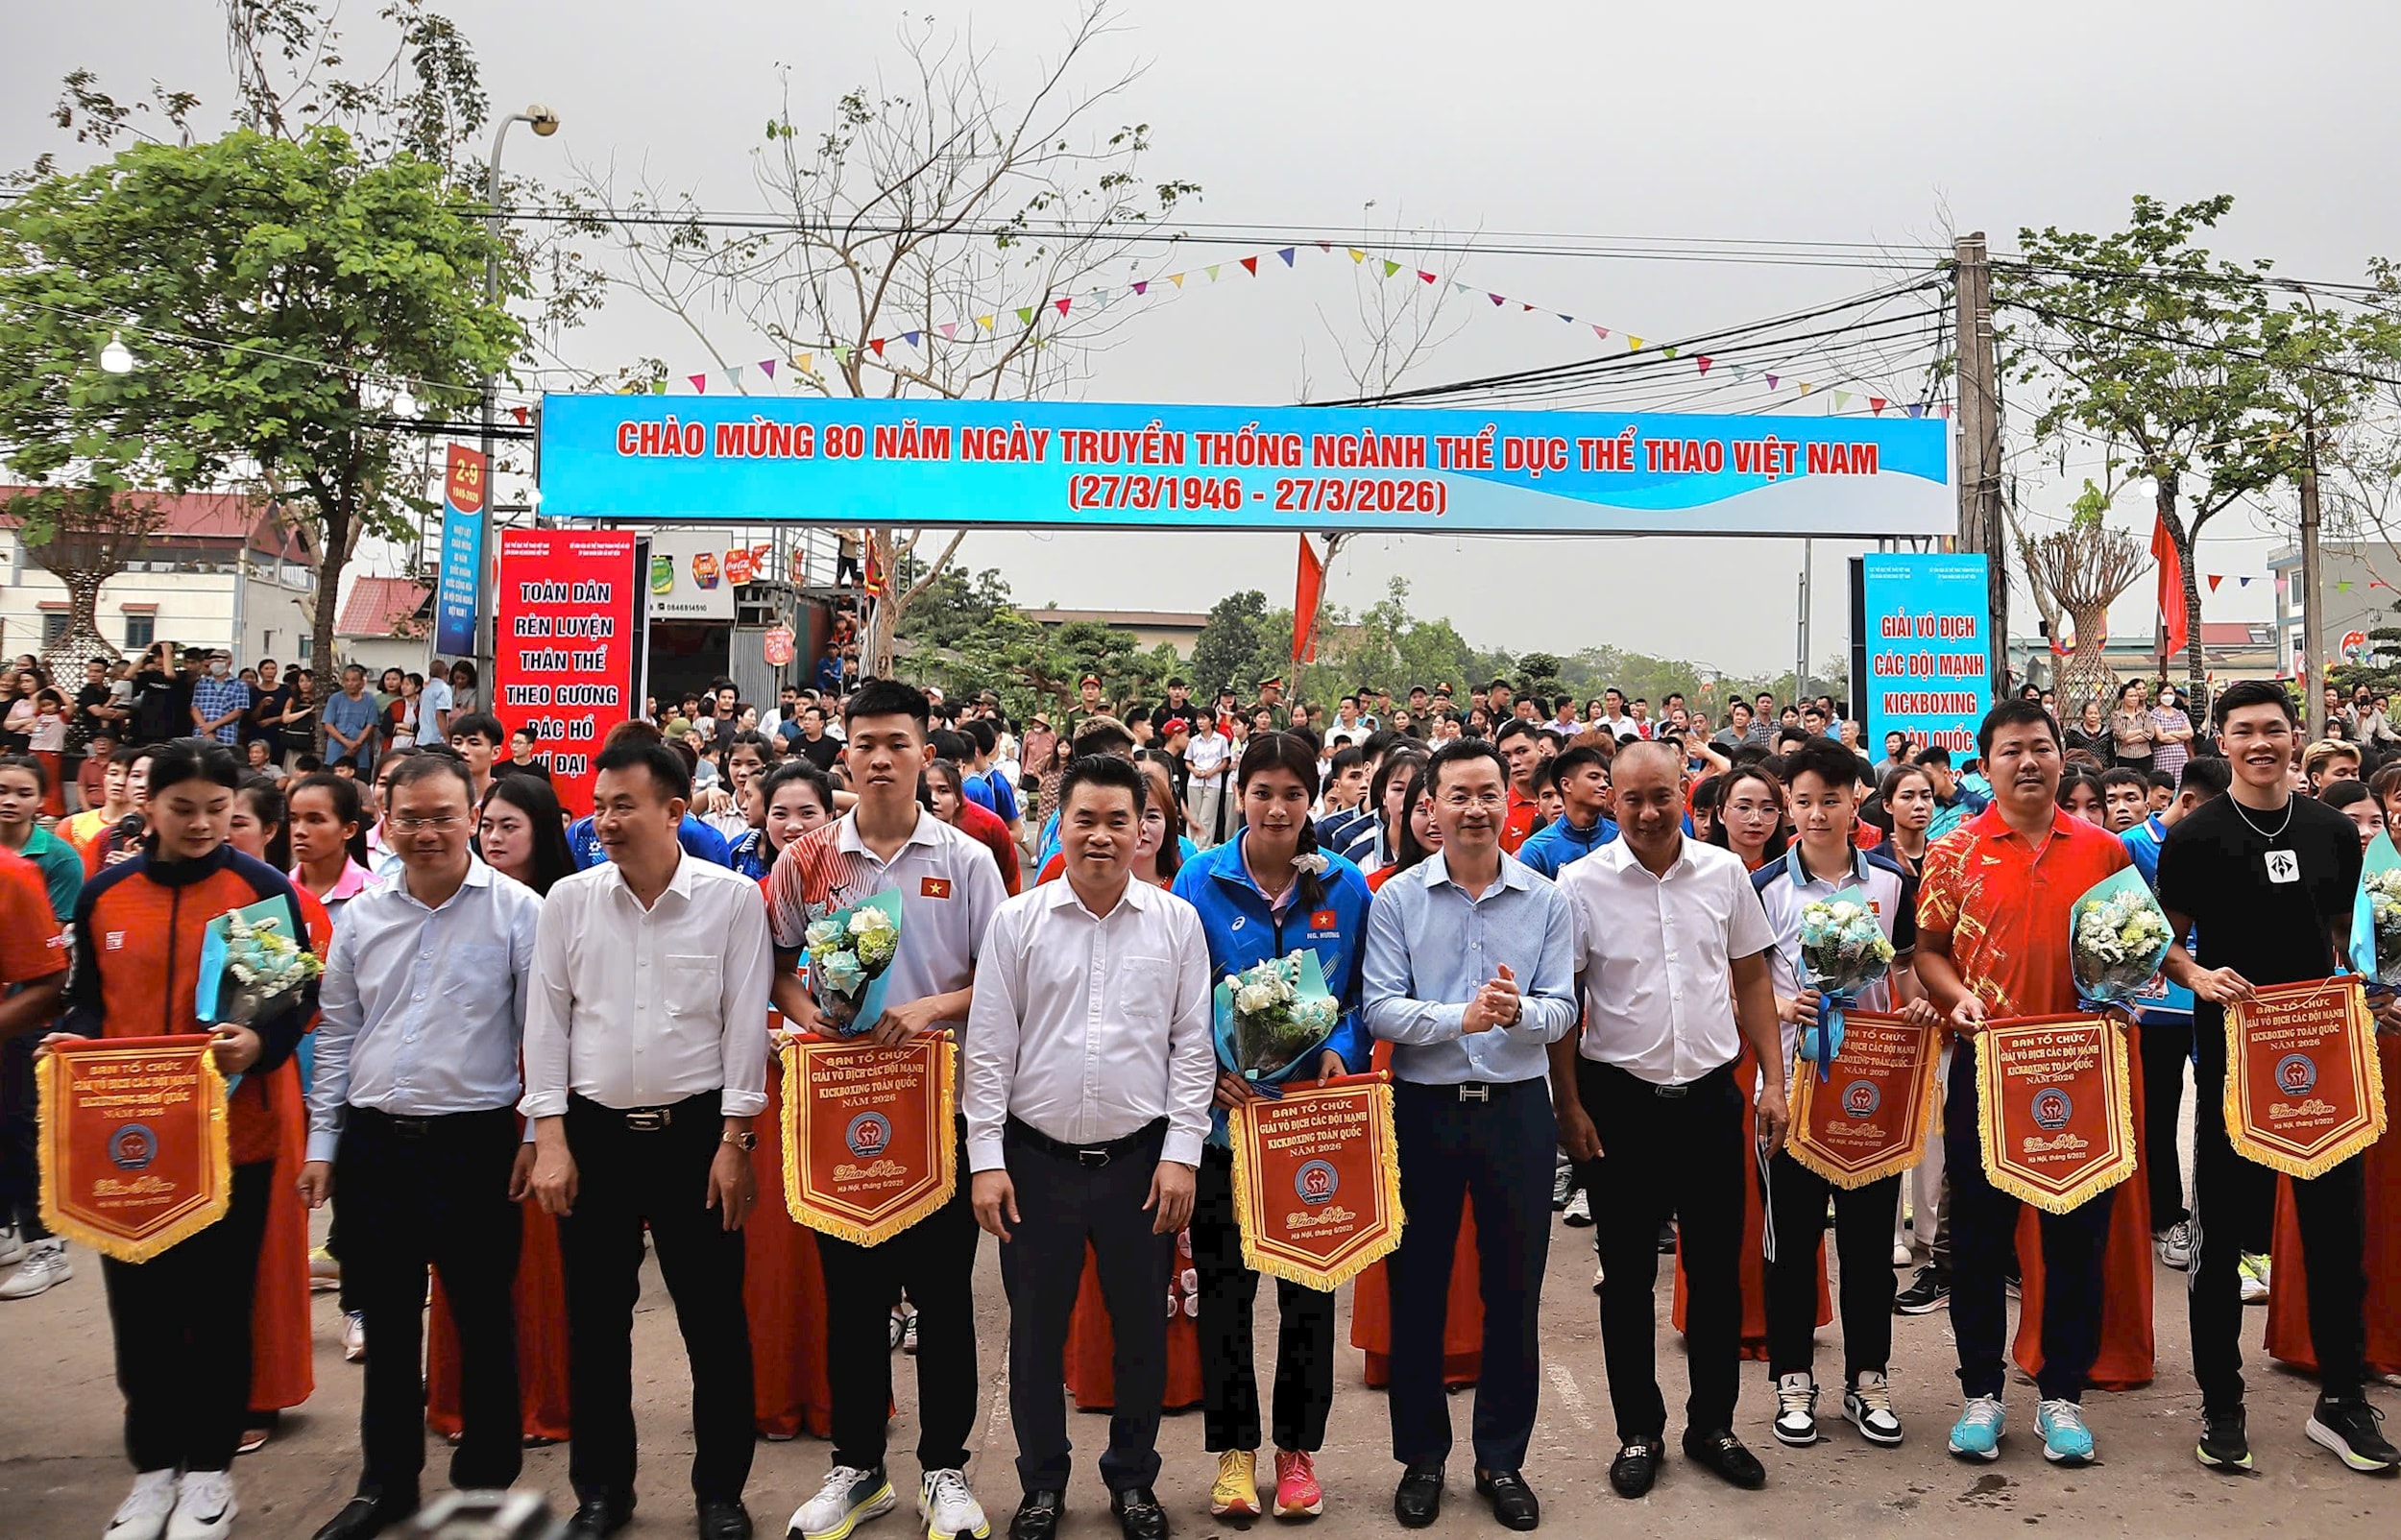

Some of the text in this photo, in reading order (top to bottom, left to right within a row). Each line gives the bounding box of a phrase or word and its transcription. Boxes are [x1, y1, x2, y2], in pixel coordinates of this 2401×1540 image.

[617, 417, 1879, 478] CHÀO MỪNG 80 NĂM NGÀY TRUYỀN THỐNG NGÀNH THỂ DỤC THỂ THAO VIỆT NAM
[455, 458, 478, 486] 2-9
[1068, 475, 1242, 512] (27/3/1946
[1273, 479, 1447, 517] 27/3/2026)
[521, 579, 610, 602] TOÀN DÂN
[515, 614, 614, 640] RÈN LUYỆN
[1881, 607, 1976, 642] GIẢI VÔ ĐỊCH
[520, 644, 607, 670] THÂN THỂ
[1874, 649, 1985, 682] CÁC ĐỘI MẠNH
[506, 684, 618, 705] THEO GƯƠNG
[1883, 691, 1977, 715] KICKBOXING
[569, 713, 594, 739] HỒ
[1933, 722, 1974, 753] QUỐC
[555, 754, 587, 779] ĐẠI
[2256, 1005, 2280, 1014] BAN
[2302, 998, 2330, 1009] CHỨC
[2260, 1015, 2271, 1026] VÔ
[2272, 1015, 2291, 1027] ĐỊCH
[2292, 1012, 2308, 1023] CÁC
[2308, 1010, 2321, 1023] ĐỘI
[2322, 1008, 2344, 1021] MẠNH
[1844, 1028, 1906, 1042] AN TỔ CHỨC
[2012, 1033, 2086, 1047] BAN TỔ CHỨC
[2251, 1021, 2340, 1043] KICKBOXING TOÀN QUỐC
[2017, 1048, 2027, 1060] VÔ
[2028, 1049, 2046, 1061] ĐỊCH
[2046, 1046, 2062, 1057] CÁC
[2063, 1046, 2076, 1058] ĐỘI
[2270, 1038, 2320, 1050] NĂM 2026
[827, 1049, 910, 1067] BAN TỔ CHỨC
[2074, 1057, 2094, 1071] QUỐC
[812, 1068, 831, 1082] GIẢI
[845, 1069, 865, 1082] ĐỊCH
[866, 1065, 884, 1077] CÁC
[885, 1063, 899, 1076] ĐỘI
[900, 1063, 924, 1074] MẠNH
[2052, 1073, 2074, 1082] 2026
[818, 1074, 918, 1099] KICKBOXING TOÀN QUỐC
[842, 1094, 896, 1108] NĂM 2026
[1273, 1099, 1353, 1119] BAN TỔ CHỨC
[1259, 1111, 1368, 1134] GIẢI VÔ ĐỊCH CÁC ĐỘI MẠNH
[1267, 1124, 1362, 1149] KICKBOXING TOÀN QUỐC
[1290, 1143, 1342, 1158] NĂM 2026
